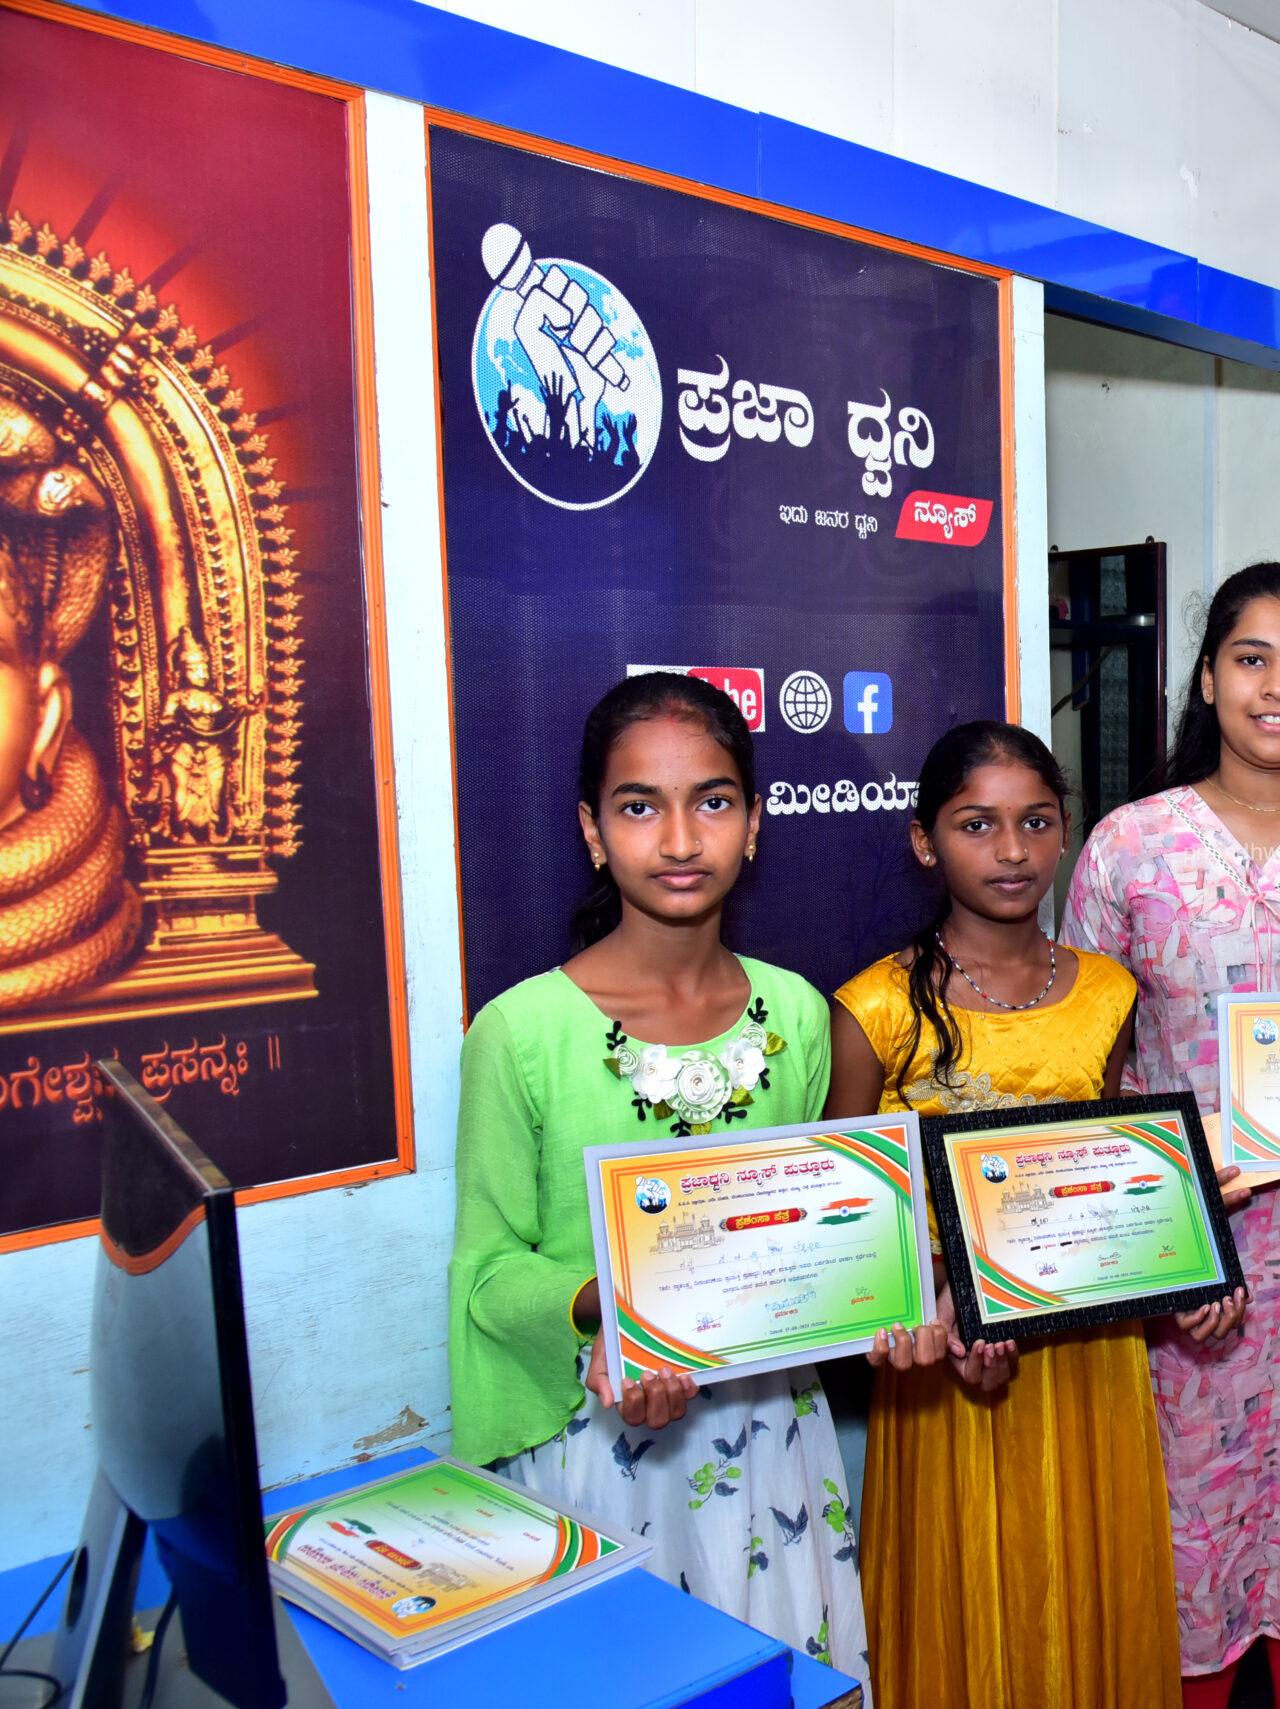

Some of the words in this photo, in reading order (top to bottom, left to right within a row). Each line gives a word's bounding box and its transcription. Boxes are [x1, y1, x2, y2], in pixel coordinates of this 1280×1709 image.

[677, 354, 815, 462] ಪ್ರಜಾ
[847, 387, 935, 498] ಧ್ವನಿ
[779, 504, 808, 524] ಇದು
[815, 510, 849, 529] ಜನರ
[855, 514, 878, 539] ಧ್ವನಿ
[914, 500, 977, 539] ನ್ಯೂಸ್
[724, 678, 757, 721] be
[736, 1164, 777, 1186] ನ್ಯೂಸ್
